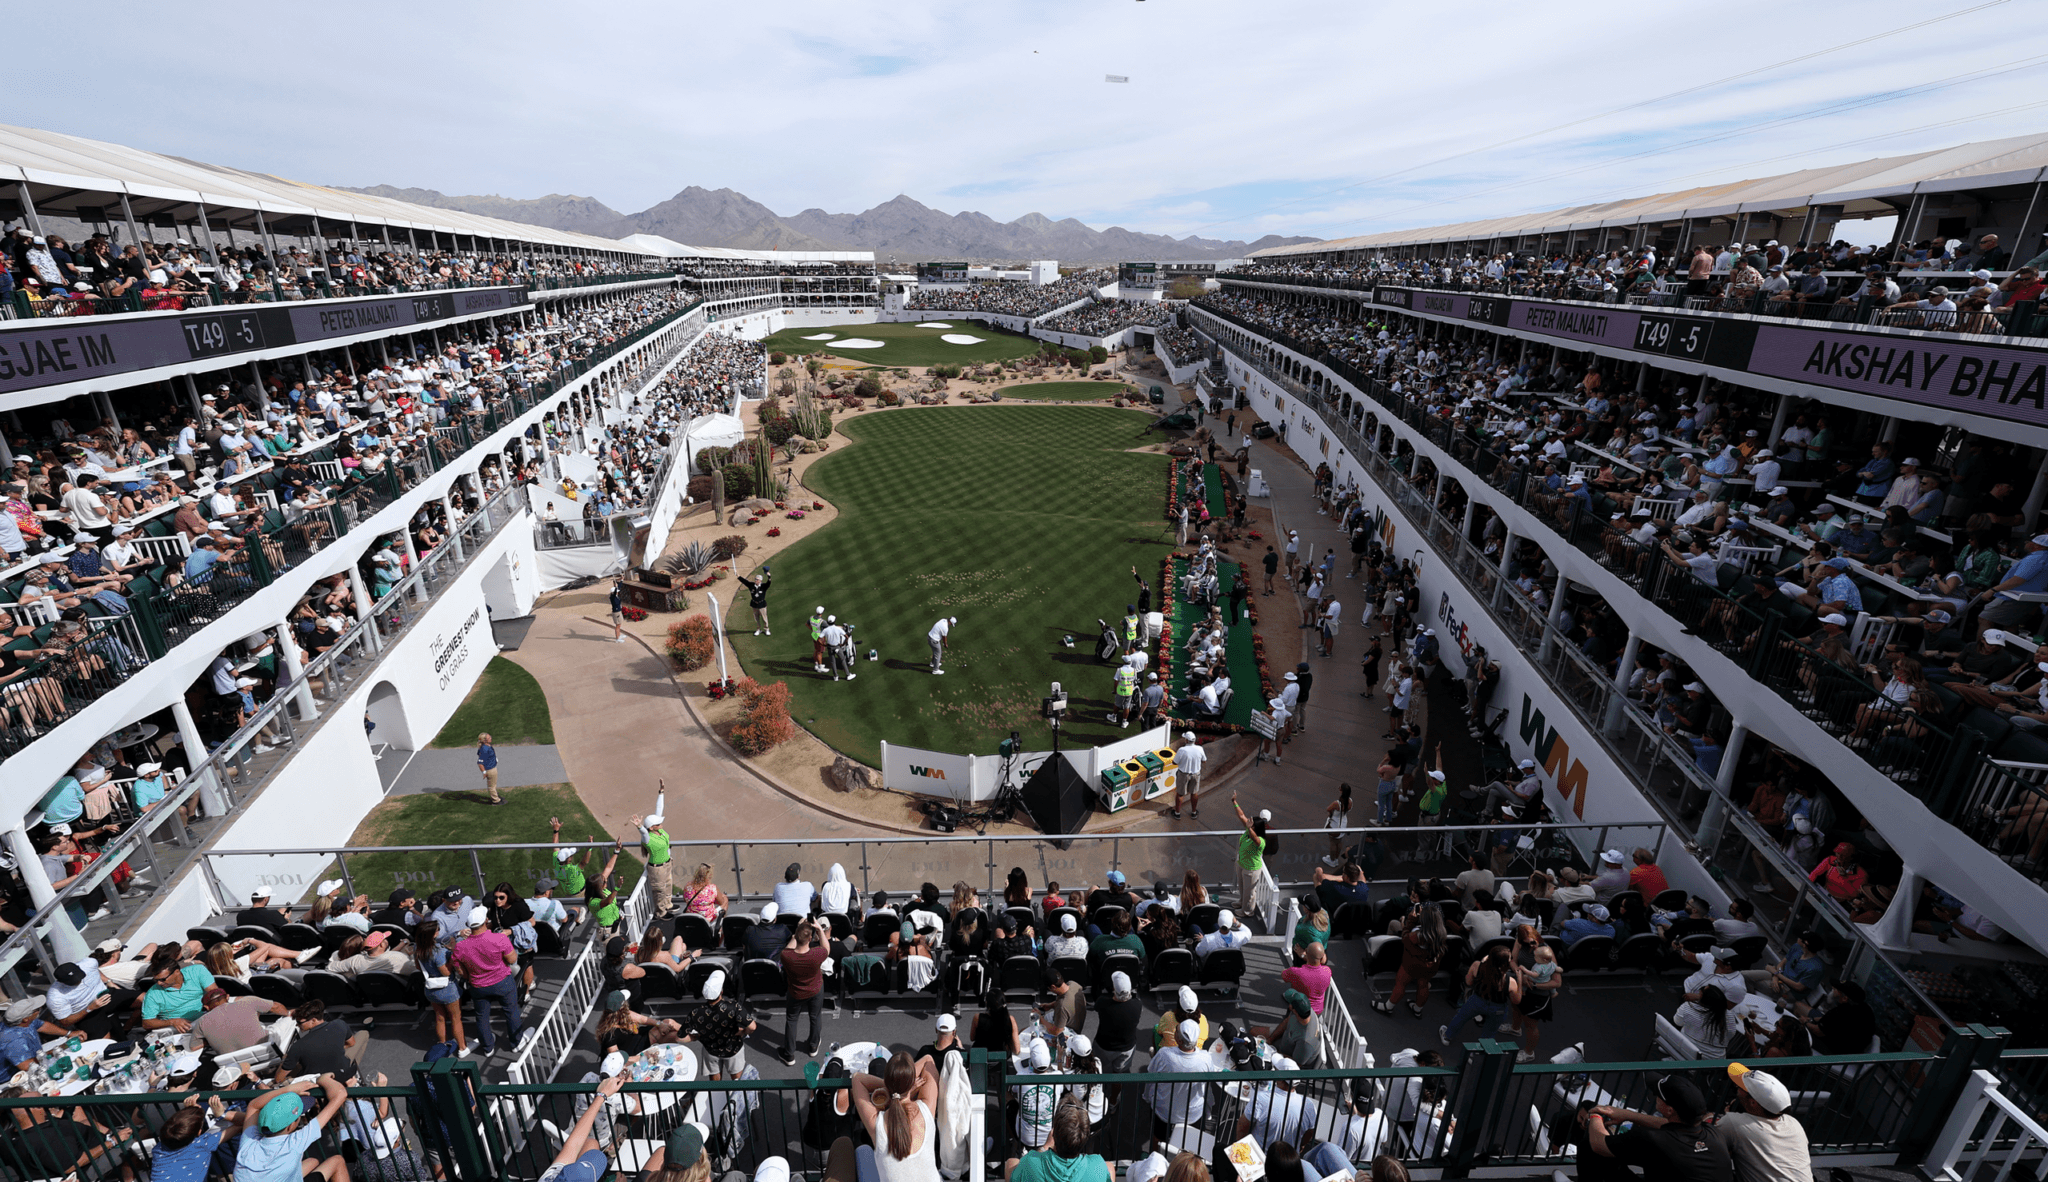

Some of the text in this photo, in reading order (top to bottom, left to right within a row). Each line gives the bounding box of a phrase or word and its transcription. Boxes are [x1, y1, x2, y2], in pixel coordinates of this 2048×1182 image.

[319, 303, 399, 332] PETER MALNATI
[414, 301, 440, 317] T49 -5
[1470, 300, 1492, 320] T49 -5
[1526, 307, 1608, 338] PETER MALNATI
[77, 334, 116, 368] IM
[185, 319, 254, 351] T49 -5
[1640, 320, 1701, 352] T49 -5
[1803, 339, 2047, 410] AKSHAY BHA
[1319, 431, 1329, 460] WM
[1375, 504, 1396, 552] WM
[429, 633, 444, 656] THE
[434, 607, 480, 673] GREENEST SHOW
[1445, 605, 1473, 659] FedEx
[439, 644, 469, 691] ON GRASS
[909, 764, 946, 780] WM
[1520, 691, 1589, 822] WM
[1019, 769, 1038, 778] W
